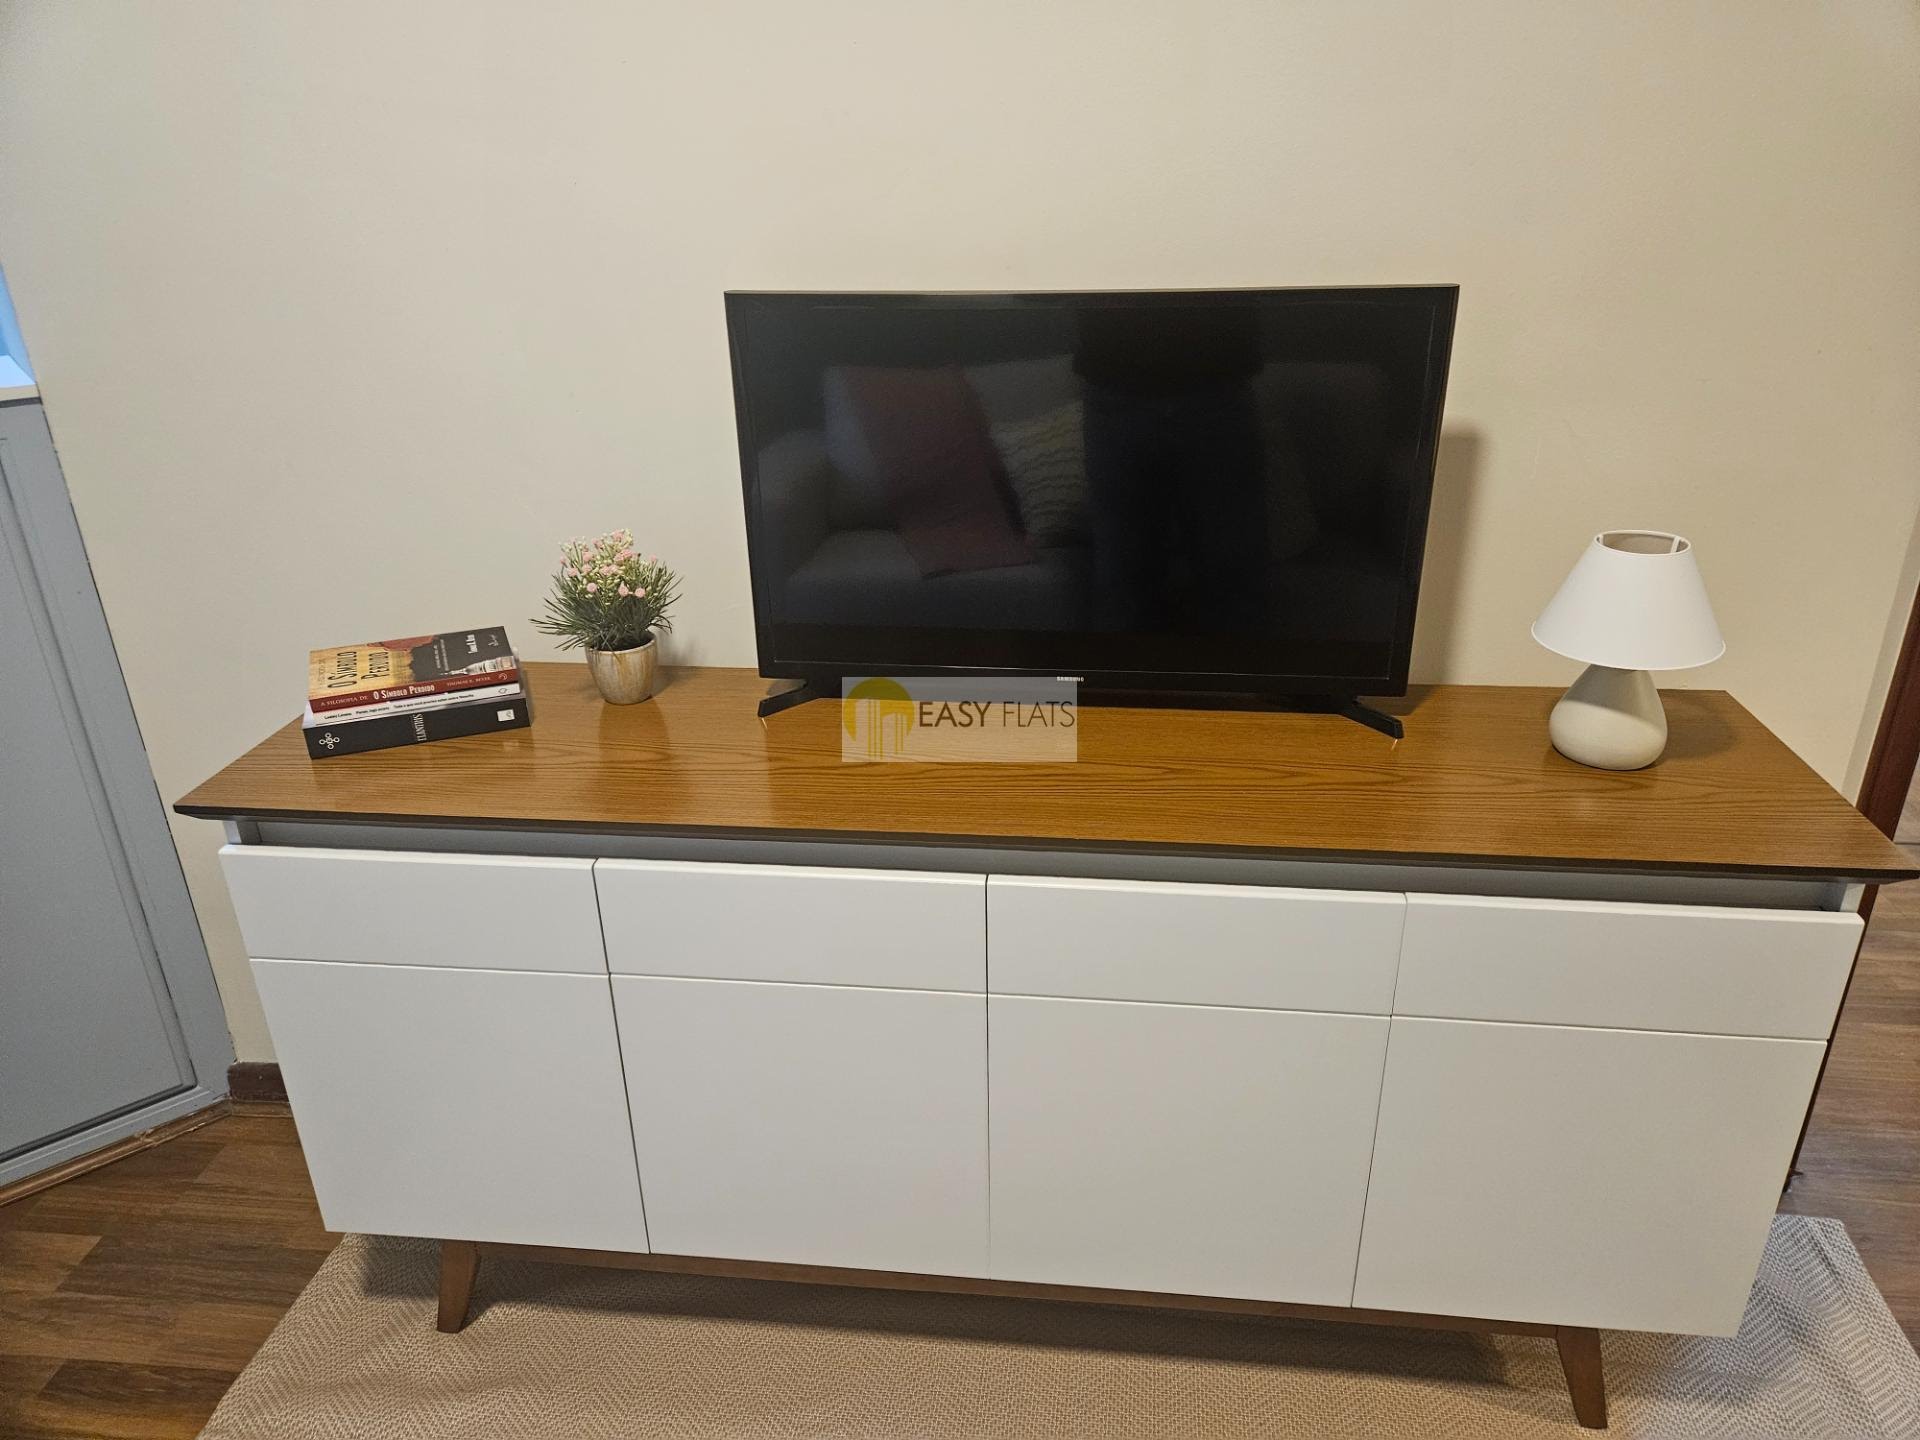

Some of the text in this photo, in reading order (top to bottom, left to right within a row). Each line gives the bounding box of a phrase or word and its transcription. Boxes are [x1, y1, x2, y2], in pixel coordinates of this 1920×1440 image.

[327, 681, 358, 689] O
[373, 690, 380, 700] O
[409, 684, 435, 695] PERDIDO
